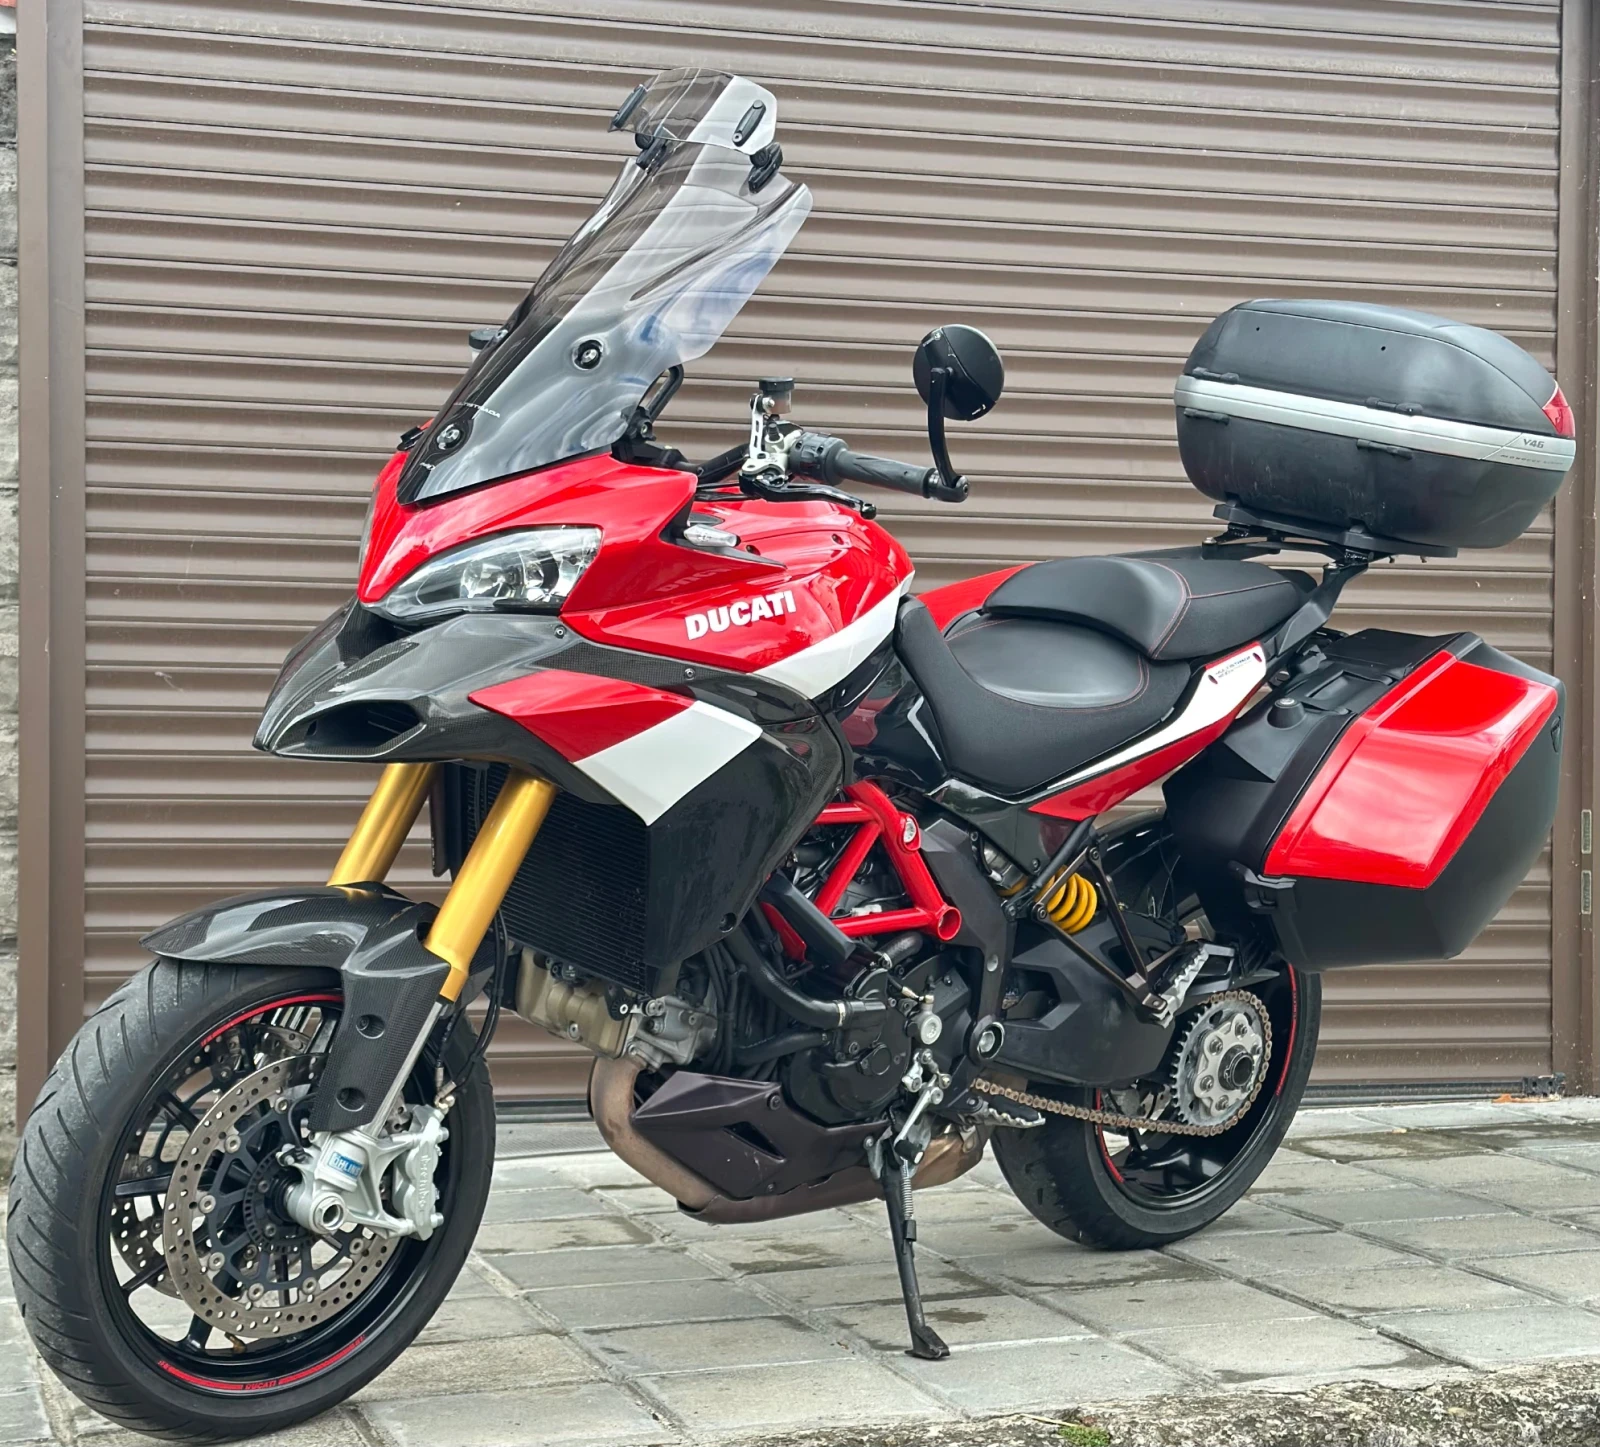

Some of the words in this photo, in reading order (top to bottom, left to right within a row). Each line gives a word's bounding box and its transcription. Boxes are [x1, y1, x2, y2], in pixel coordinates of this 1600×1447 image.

[1523, 438, 1545, 449] V46
[685, 590, 797, 640] DUCATI
[245, 1380, 276, 1390] DUCATI
